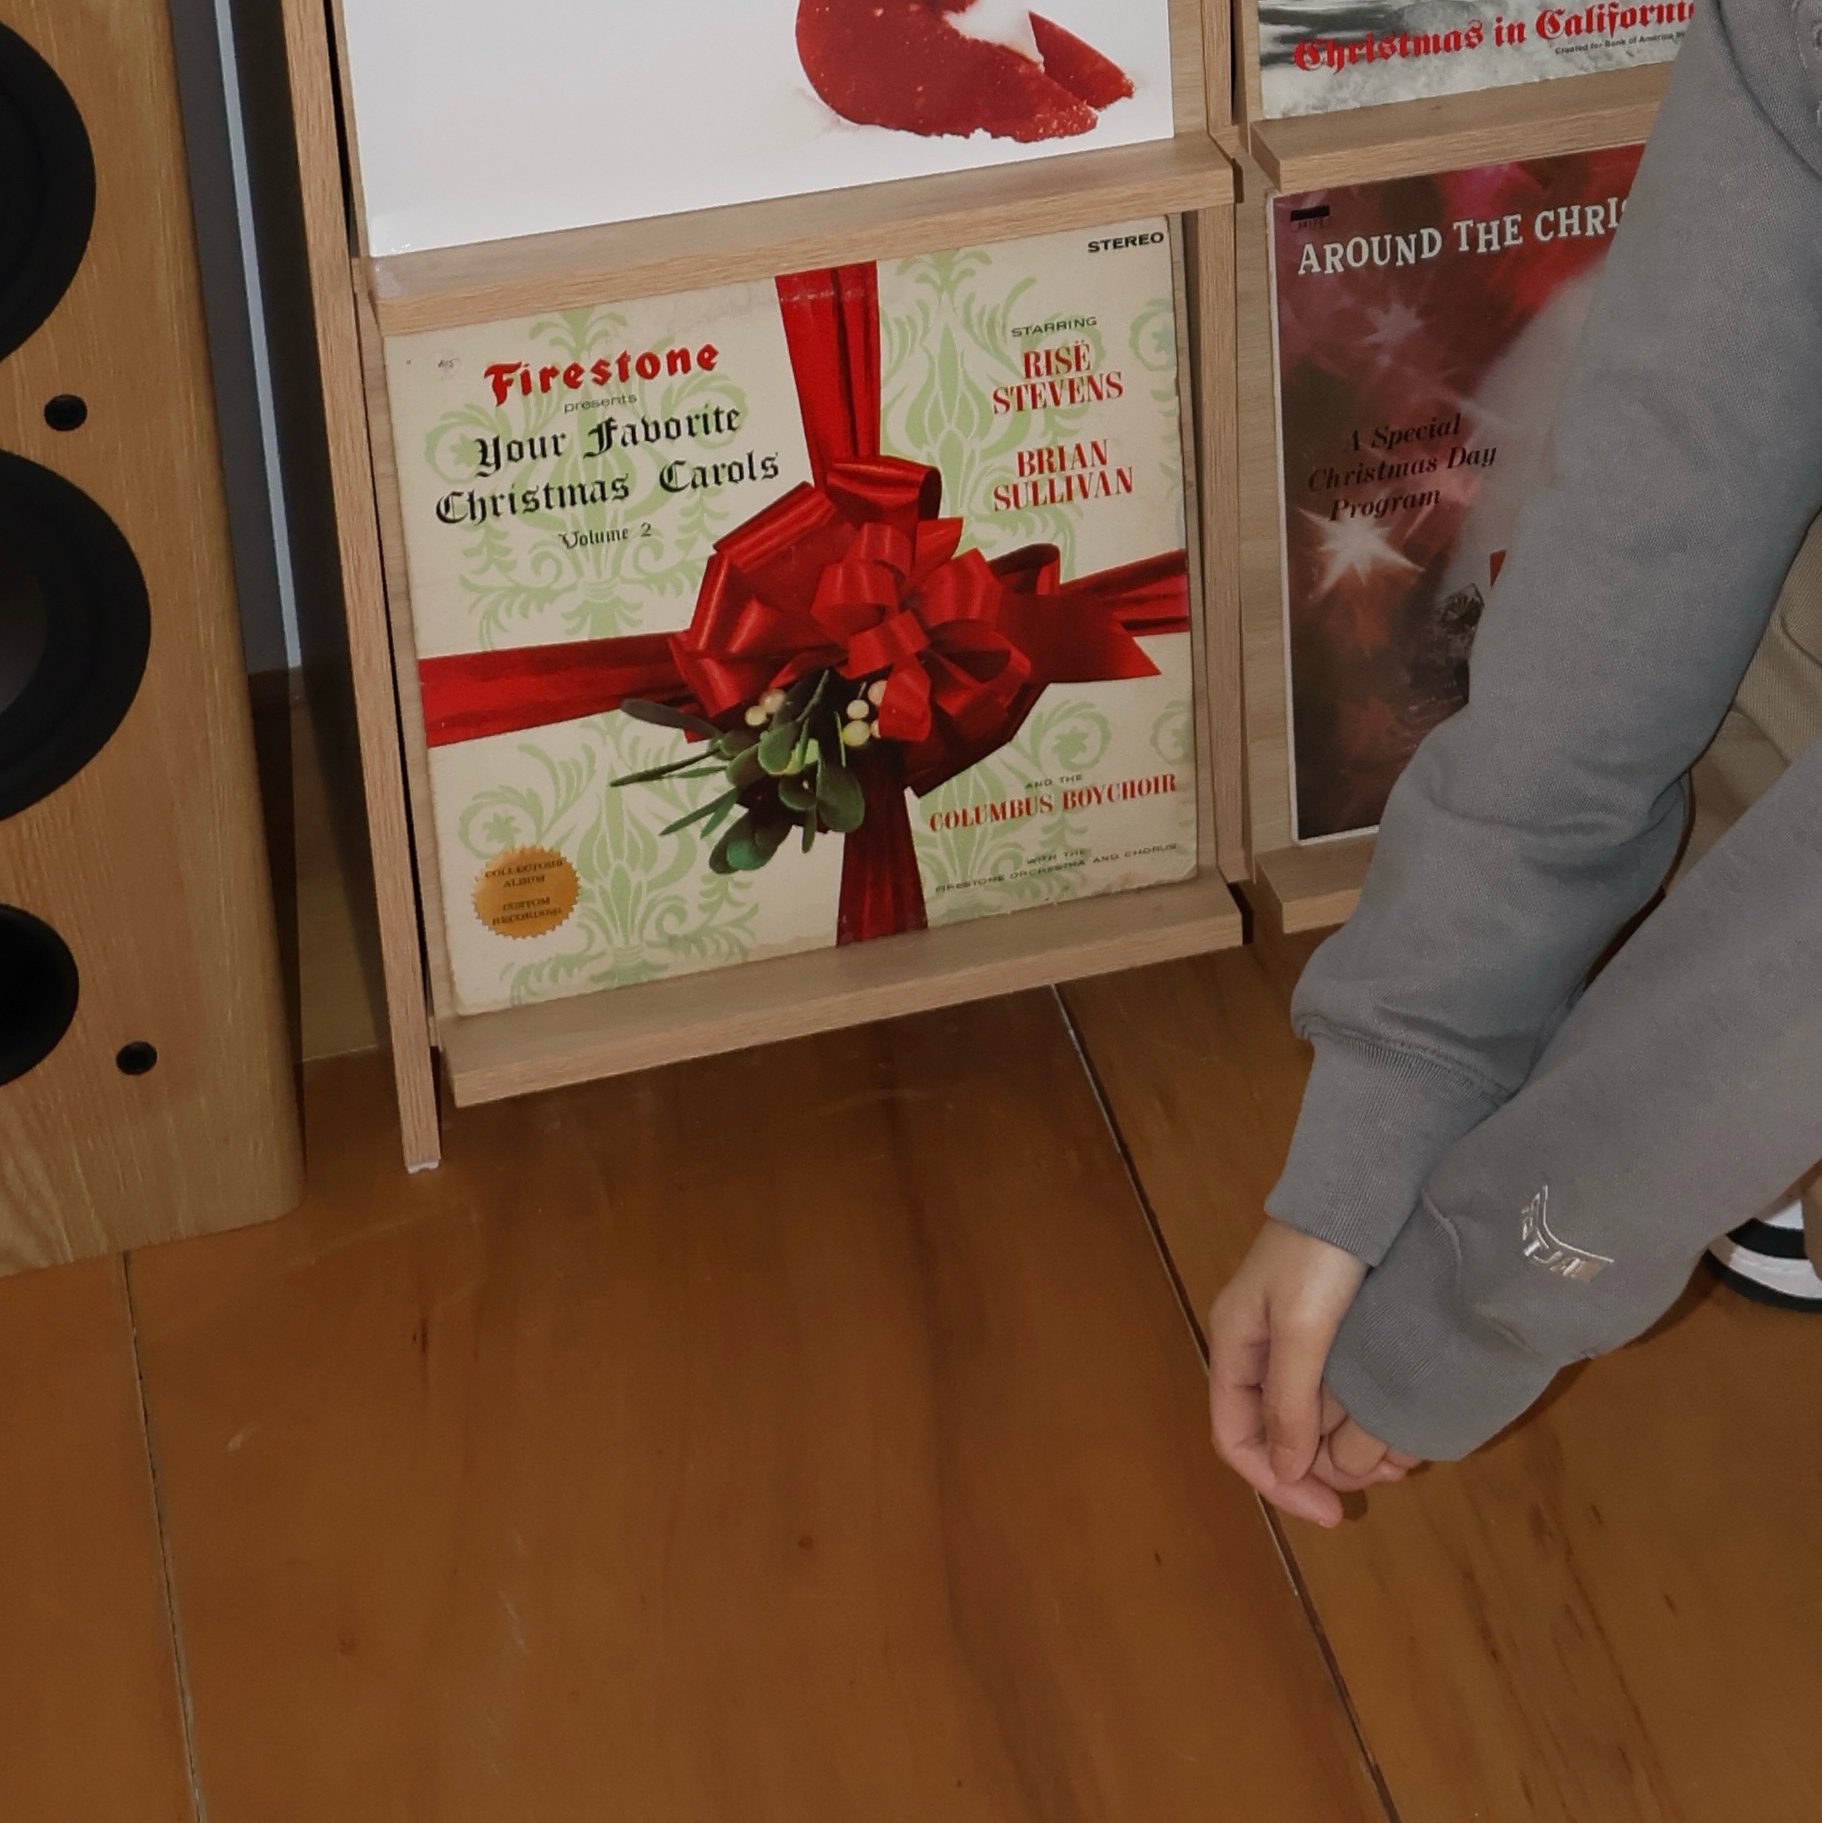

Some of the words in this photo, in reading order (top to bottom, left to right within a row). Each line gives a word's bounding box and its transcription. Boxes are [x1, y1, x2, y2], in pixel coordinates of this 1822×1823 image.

[1293, 19, 1484, 75] Christmas
[1494, 16, 1527, 47] in
[1555, 44, 1589, 55] Created
[1590, 42, 1602, 50] for
[1604, 39, 1626, 48] Bank
[1628, 36, 1637, 45] of
[1639, 32, 1674, 44] America
[1087, 231, 1164, 253] STEREO
[1298, 228, 1442, 275] AROUND
[1453, 214, 1524, 254] THE
[1534, 197, 1628, 242] CHRI
[1011, 316, 1098, 338] STARRING
[484, 343, 720, 407] Firestone
[1023, 340, 1091, 379] RISË
[563, 393, 638, 414] presents
[992, 371, 1124, 415] STEVENS
[474, 430, 567, 478] Your
[583, 404, 742, 459] Favorite
[1341, 429, 1360, 453] A
[1370, 412, 1462, 450] Special
[1016, 438, 1108, 478] BRIAN
[1308, 457, 1438, 492] Christmas
[1447, 445, 1497, 469] Day
[436, 473, 631, 525] Christmas
[659, 450, 780, 493] Carols
[993, 466, 1133, 513] SULLIVAN
[1329, 489, 1441, 522] Program
[558, 527, 629, 550] Volume
[641, 522, 652, 538] 2
[1025, 779, 1053, 789] AND
[1059, 774, 1083, 783] THE
[929, 793, 1054, 833] COLUMBUS
[1061, 773, 1177, 812] BOYCHOIR
